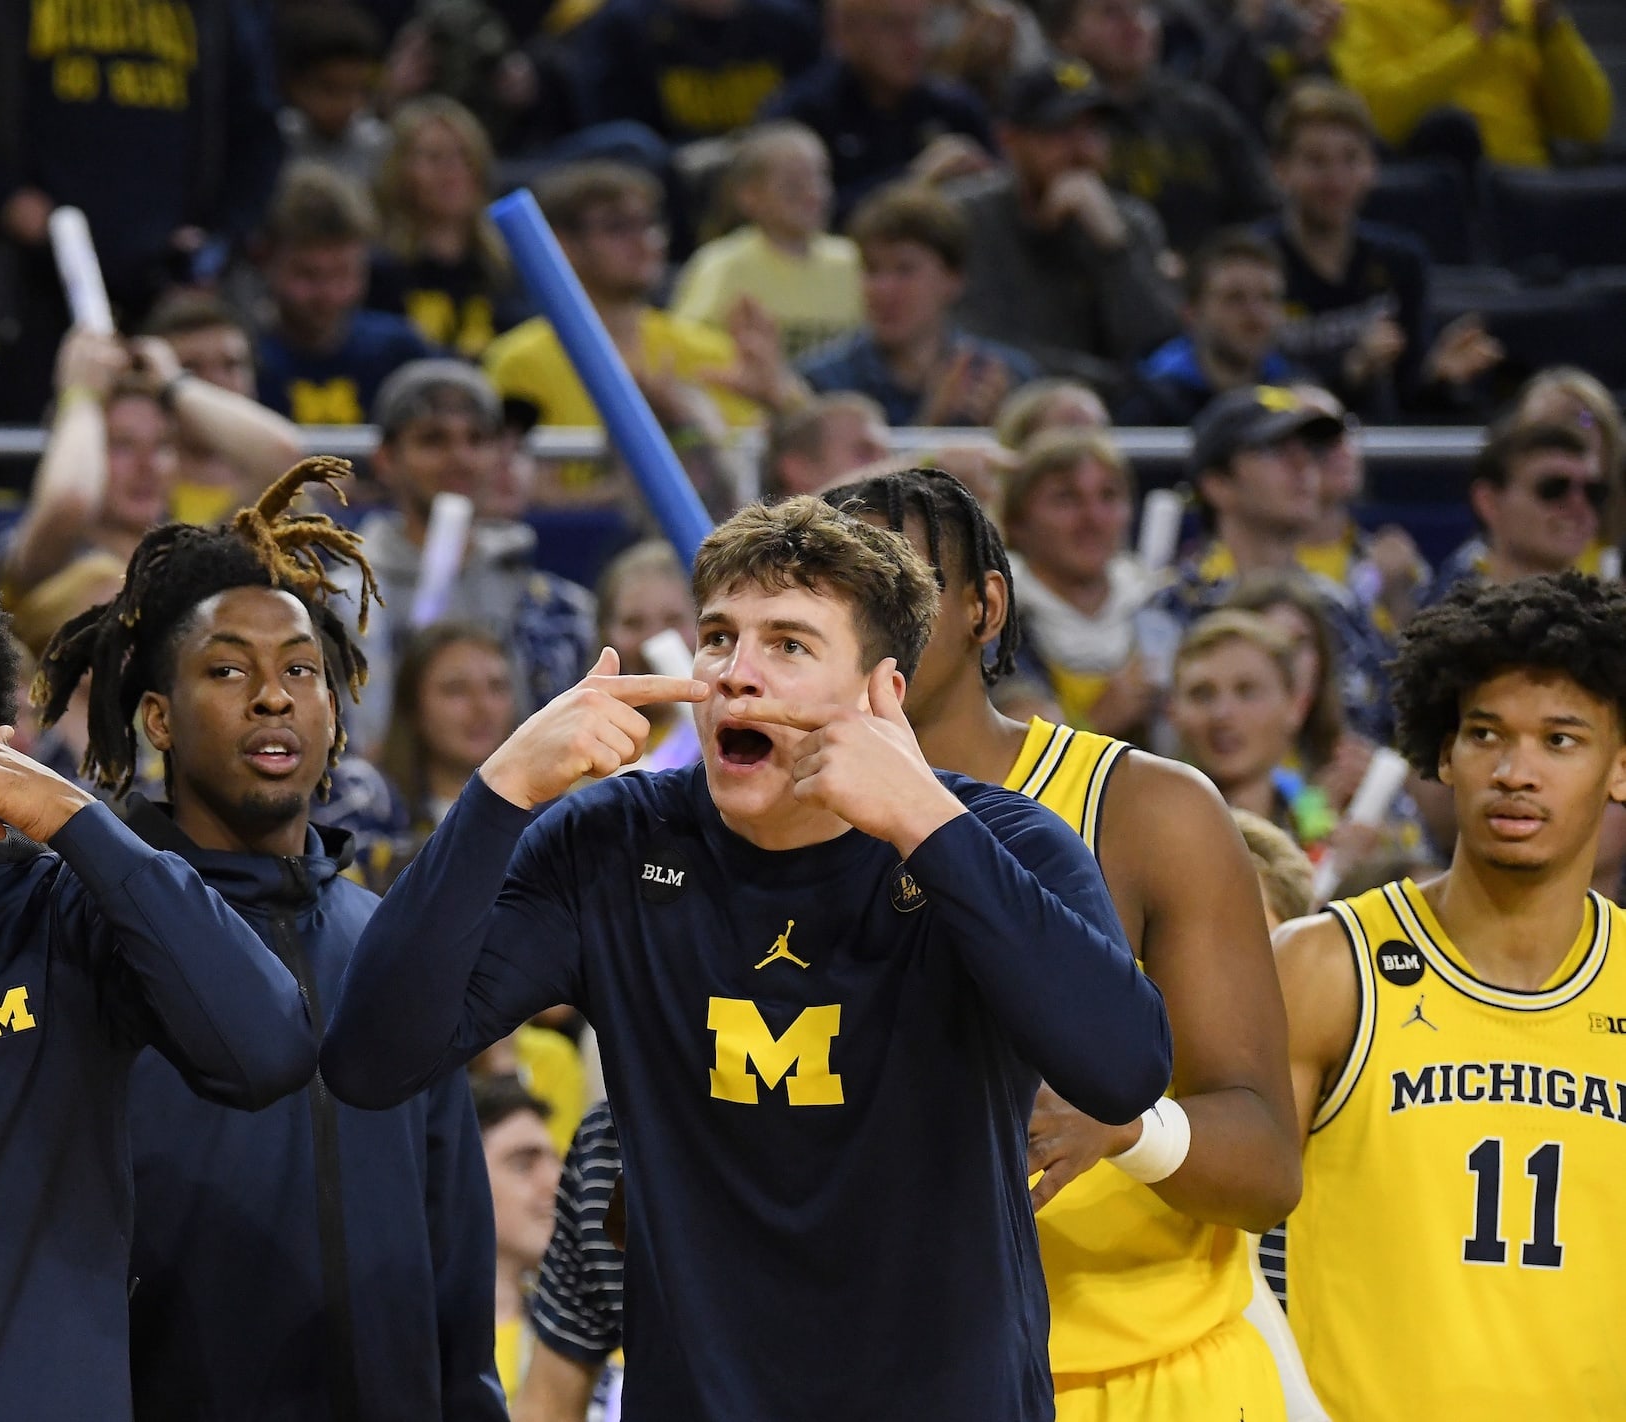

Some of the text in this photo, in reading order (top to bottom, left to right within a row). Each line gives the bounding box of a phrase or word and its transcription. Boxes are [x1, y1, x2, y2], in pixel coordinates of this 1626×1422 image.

[641, 863, 685, 887] BLM
[1381, 954, 1421, 971] BLM
[706, 996, 845, 1106] M
[1463, 1137, 1564, 1269] 11
